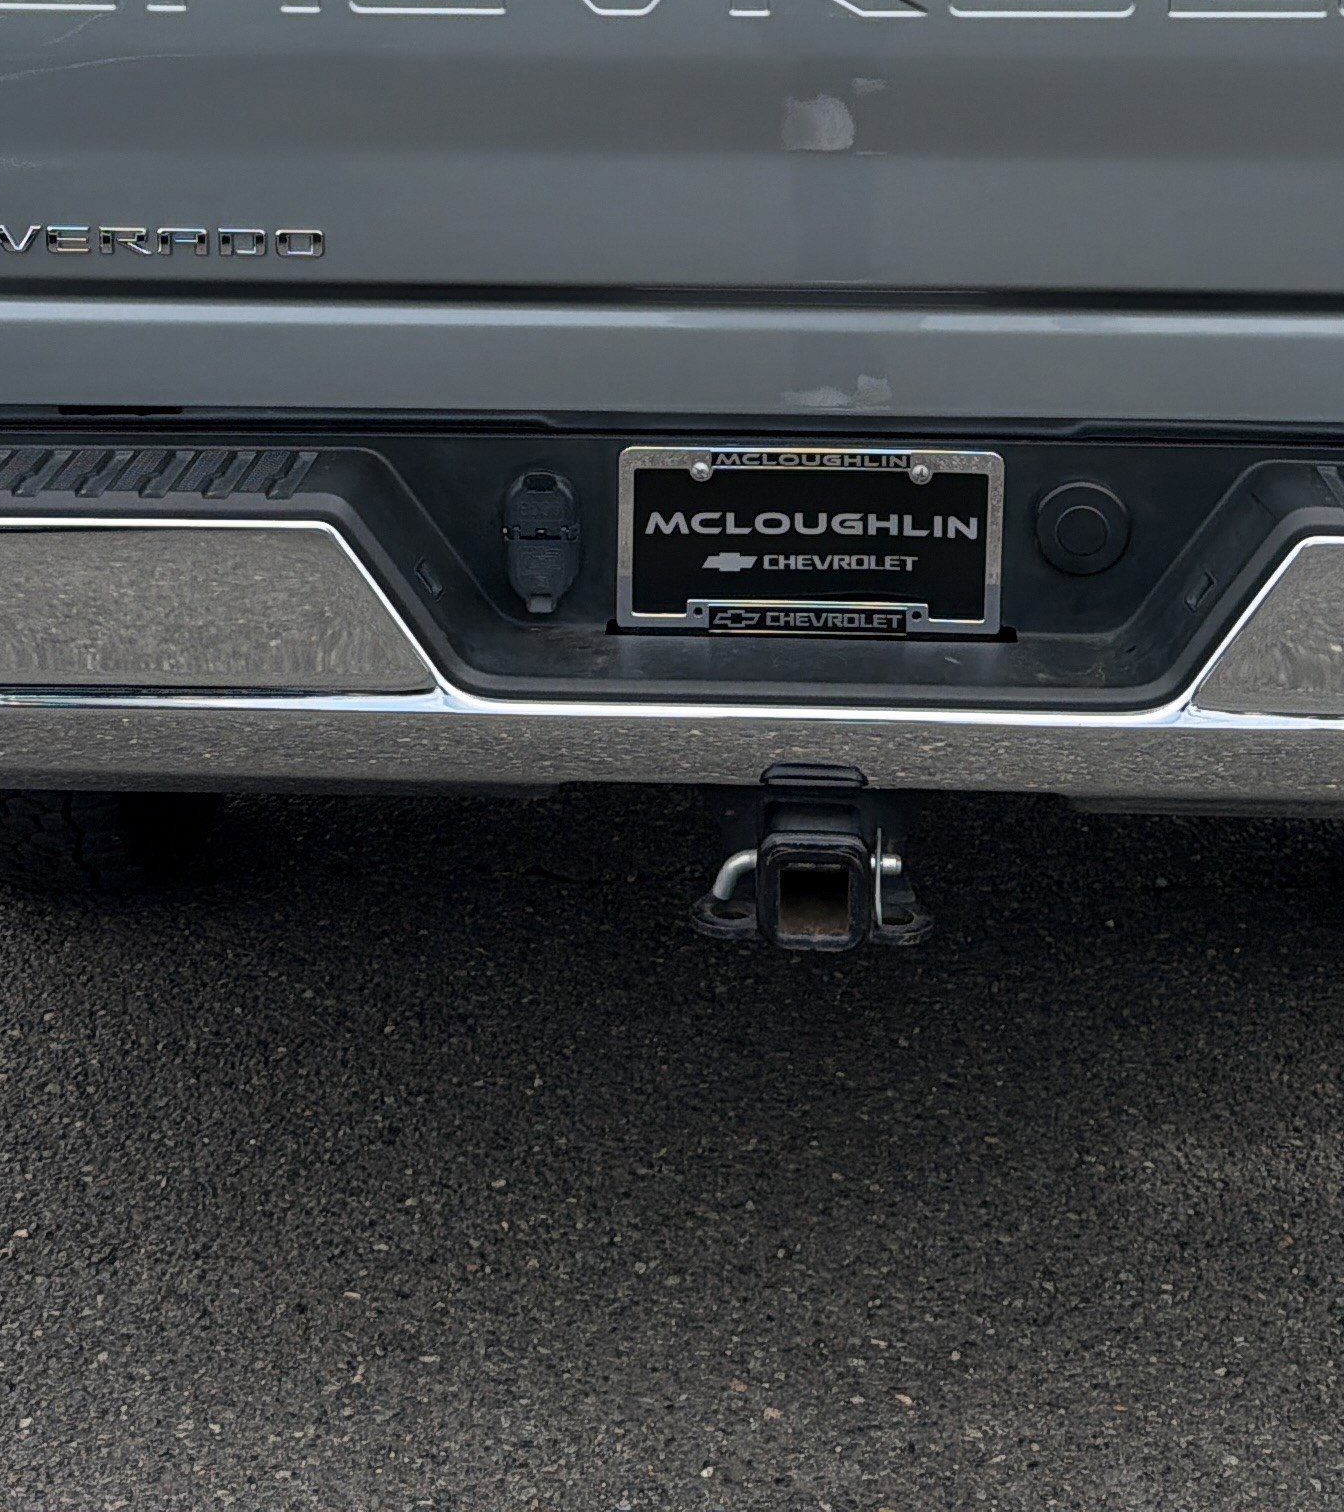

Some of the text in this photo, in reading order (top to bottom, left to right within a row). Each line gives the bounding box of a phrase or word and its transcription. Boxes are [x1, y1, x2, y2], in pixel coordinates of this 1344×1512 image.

[714, 453, 908, 468] MCLOUGHLIN
[645, 511, 979, 540] MCLOUGHLIN
[762, 553, 919, 571] CHEVROLET
[765, 611, 903, 630] CHEVROLET
